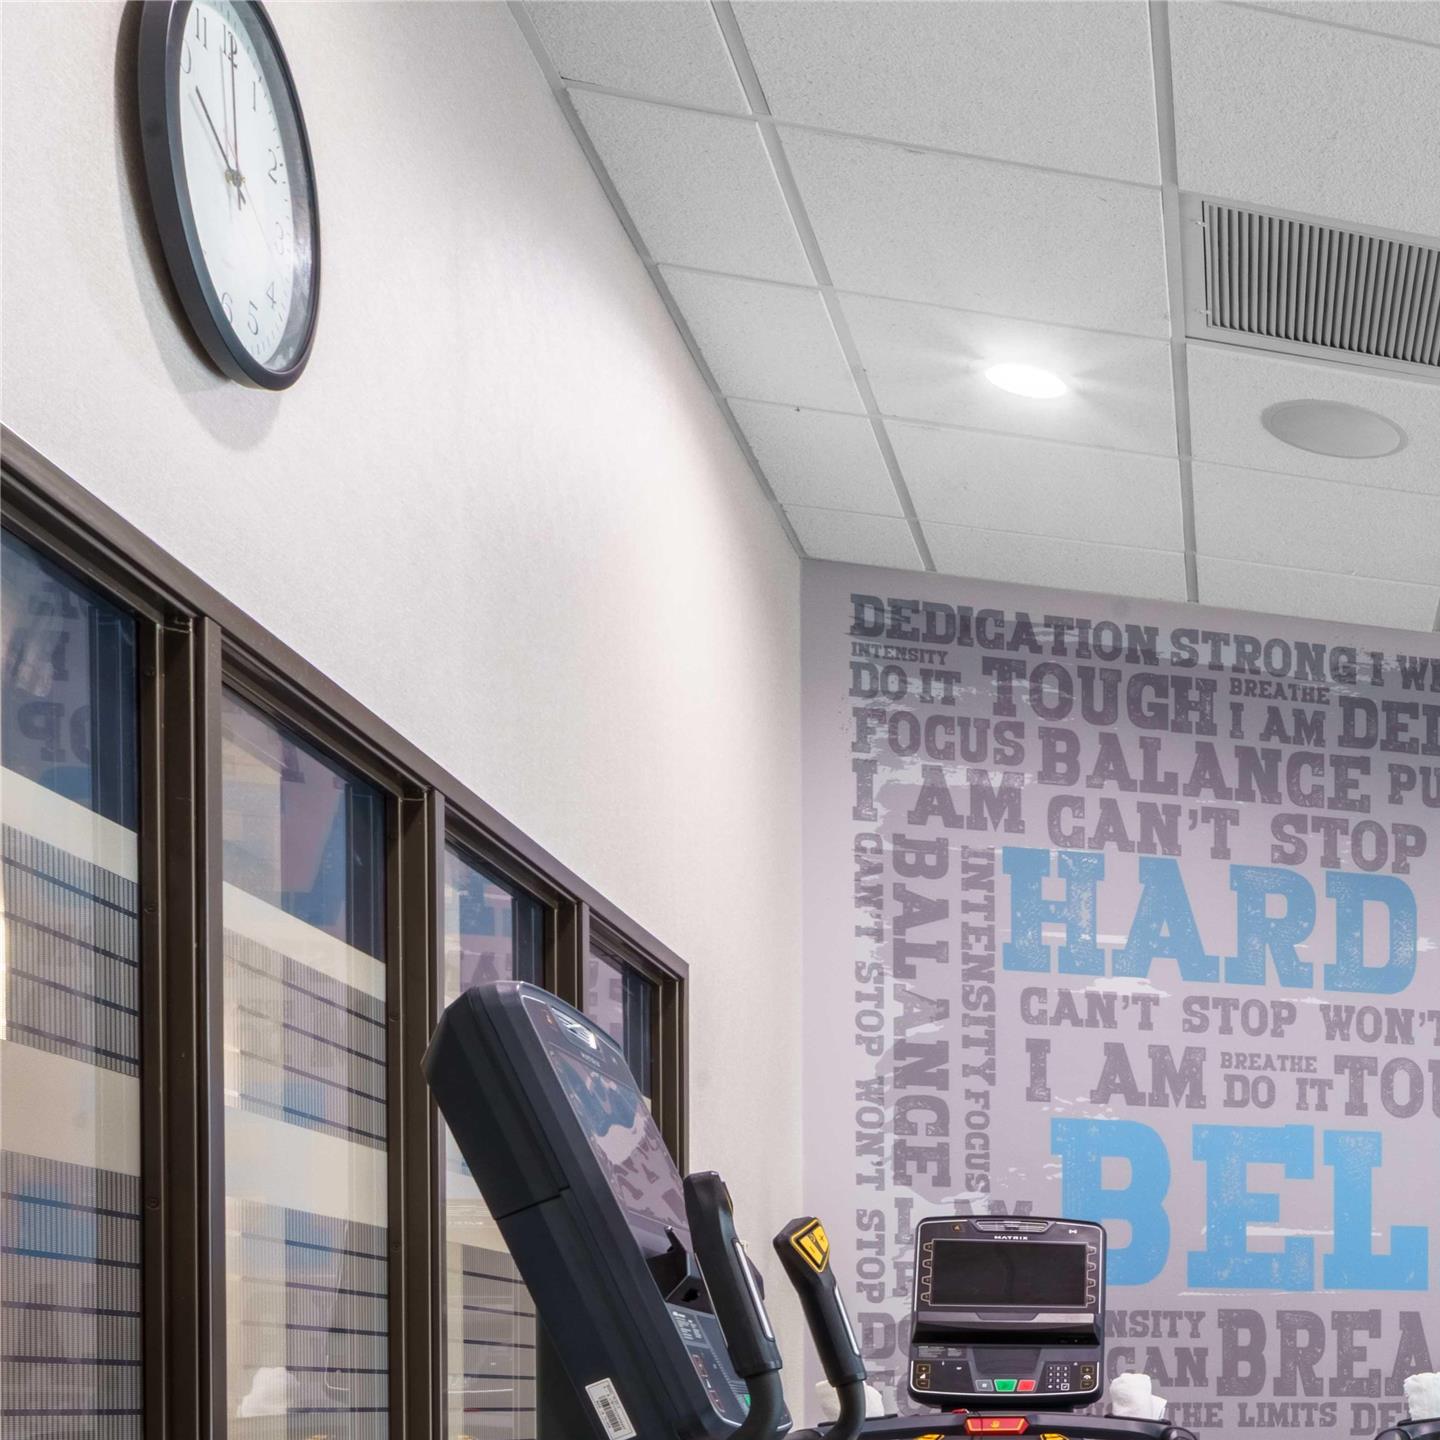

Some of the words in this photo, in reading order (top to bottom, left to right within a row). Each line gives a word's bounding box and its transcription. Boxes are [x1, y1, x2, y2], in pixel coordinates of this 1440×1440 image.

[195, 9, 207, 48] 11
[253, 82, 256, 112] 1
[268, 149, 277, 183] 2
[850, 593, 1160, 666] DEDICATION
[1171, 629, 1356, 688] STRONG
[1370, 651, 1385, 687] I
[851, 642, 948, 665] INTENSITY
[849, 661, 908, 700] DO
[916, 668, 961, 706] IT
[981, 654, 1216, 738] TOUGH
[1229, 678, 1330, 705] BREATHE
[1229, 701, 1245, 740] I
[1259, 705, 1326, 748] AM
[850, 706, 1025, 766] FOCUS
[1038, 726, 1371, 813] BALANCE
[851, 759, 878, 821] I
[907, 766, 1025, 834] AM
[1047, 796, 1239, 860] CAN'T
[1270, 812, 1426, 874] STOP
[1002, 846, 1418, 994] HARD
[960, 845, 996, 1086] INTENSITY
[855, 961, 885, 1057] STOP
[892, 833, 951, 1187] BALANCE
[1020, 987, 1159, 1031] CAN'T
[1182, 996, 1297, 1038] STOP
[1025, 1039, 1051, 1103] I
[1090, 1042, 1206, 1109] AM
[1220, 1052, 1317, 1074] BREATHE
[1224, 1075, 1276, 1109] DO
[1296, 1077, 1334, 1113] IT
[856, 1075, 885, 1191] WON'T
[964, 1089, 990, 1193] FOCUS
[856, 1209, 885, 1303] STOP
[1238, 1402, 1337, 1428] LIMITS
